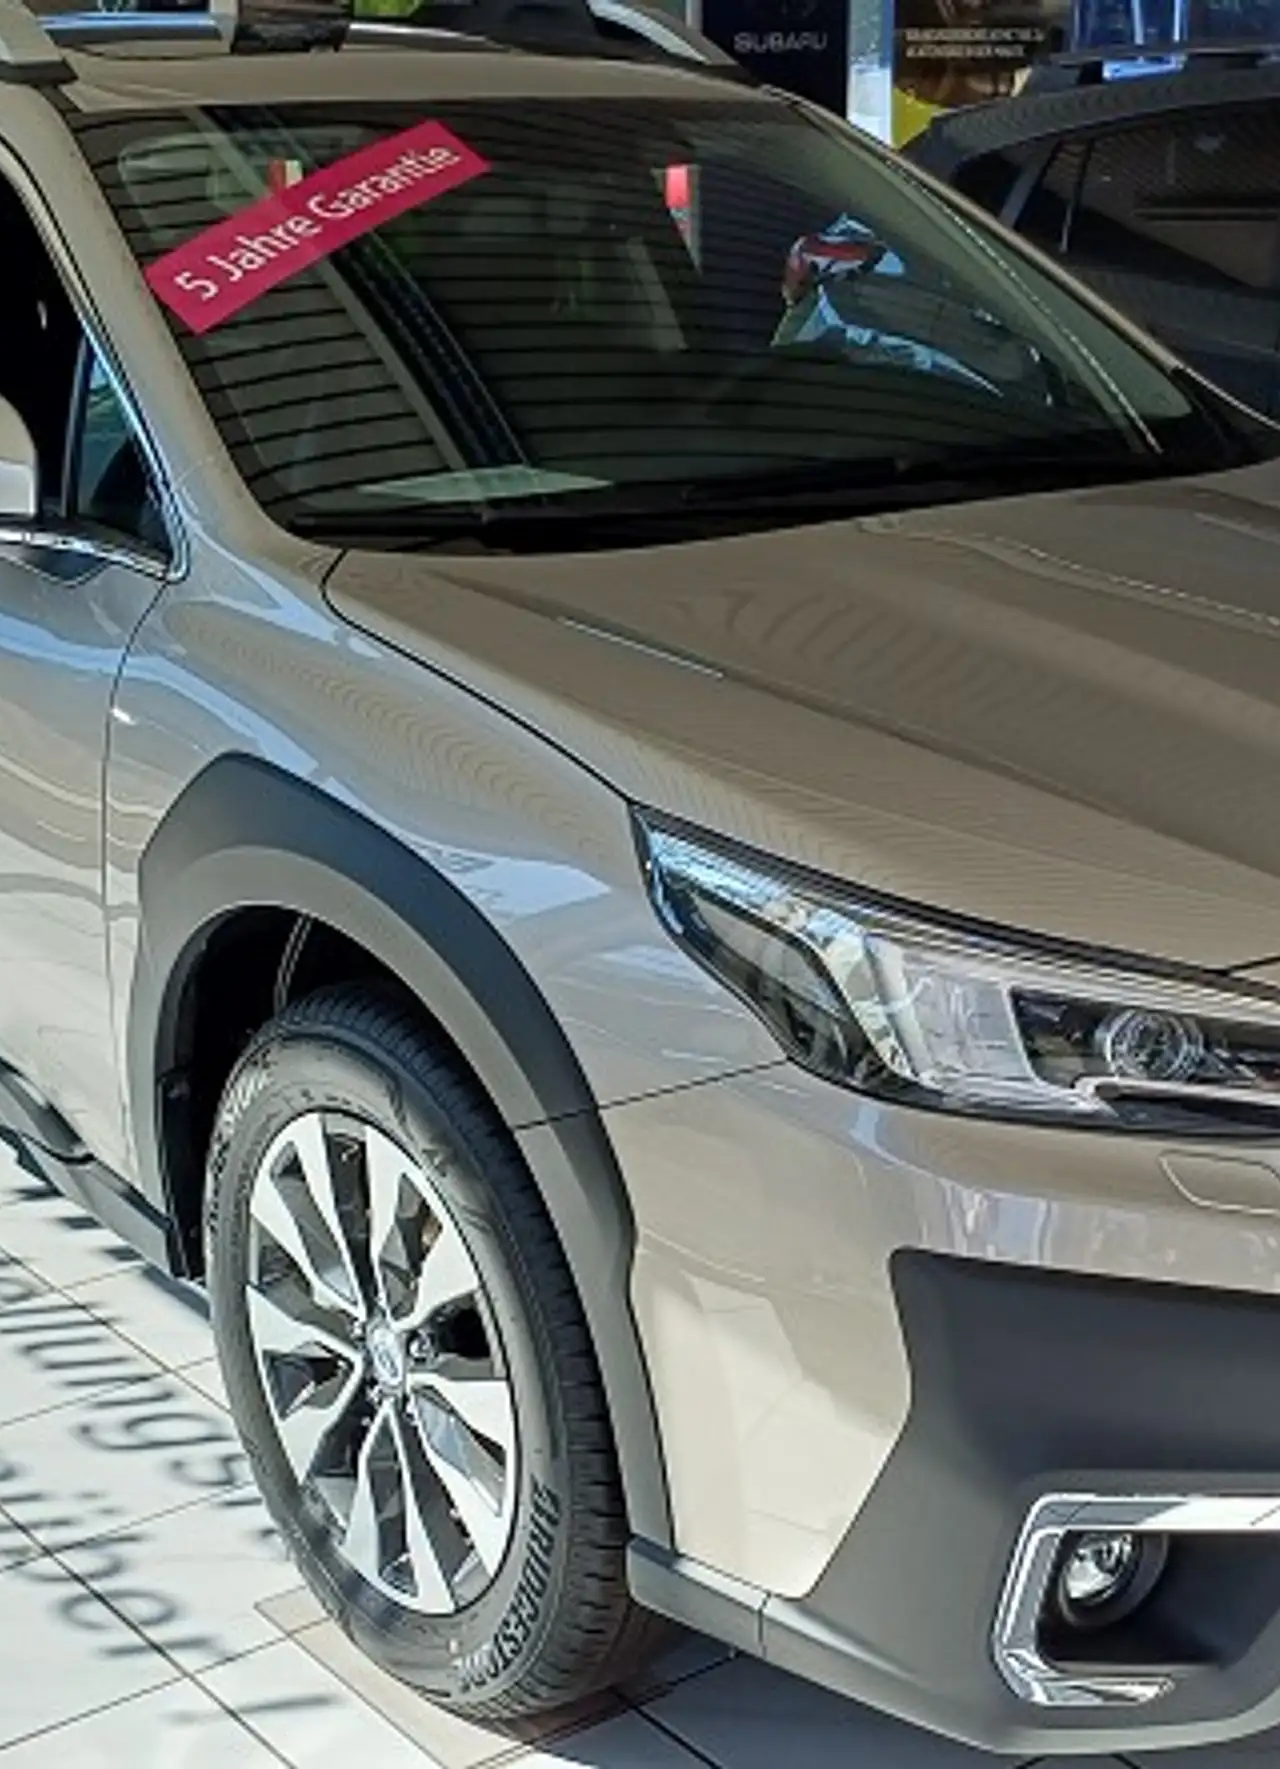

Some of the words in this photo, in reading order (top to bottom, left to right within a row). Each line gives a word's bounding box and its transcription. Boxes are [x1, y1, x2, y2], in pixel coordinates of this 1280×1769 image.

[733, 32, 829, 53] SUBARU
[174, 268, 221, 302] 5
[217, 213, 321, 281] Jahre
[307, 144, 462, 221] Garantie
